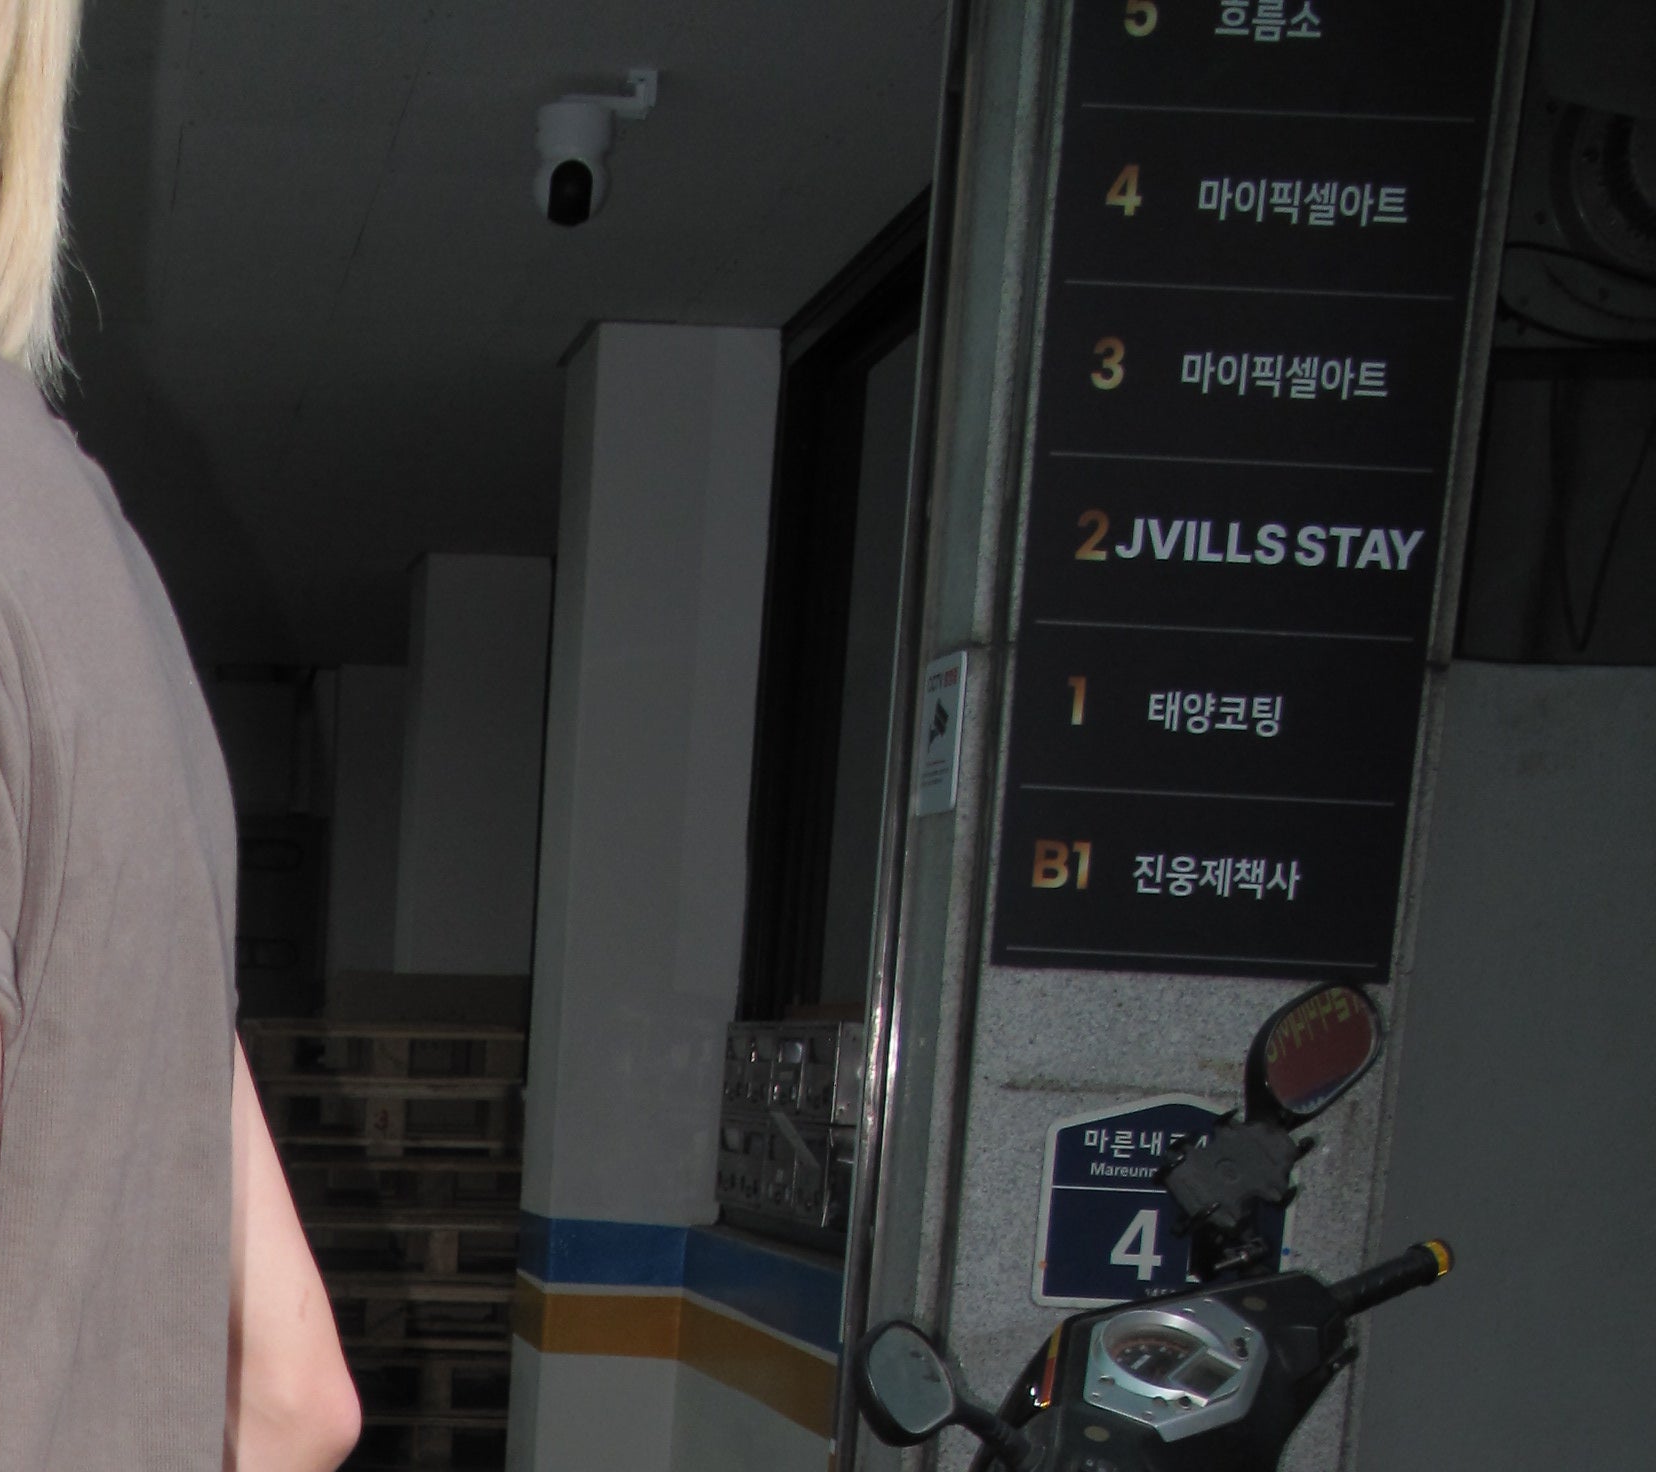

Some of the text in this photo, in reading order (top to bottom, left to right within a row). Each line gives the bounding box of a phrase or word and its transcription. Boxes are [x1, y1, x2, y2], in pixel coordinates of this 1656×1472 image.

[1124, 0, 1323, 42] 5 흐름소
[1105, 163, 1409, 227] 4 마이픽셀아트
[1090, 335, 1389, 400] 3 마이픽셀아트
[1075, 508, 1426, 571] 2 JVILLS STAY
[1067, 675, 1284, 738] 1 태양코팅
[1031, 838, 1302, 901] B1 진웅제책사
